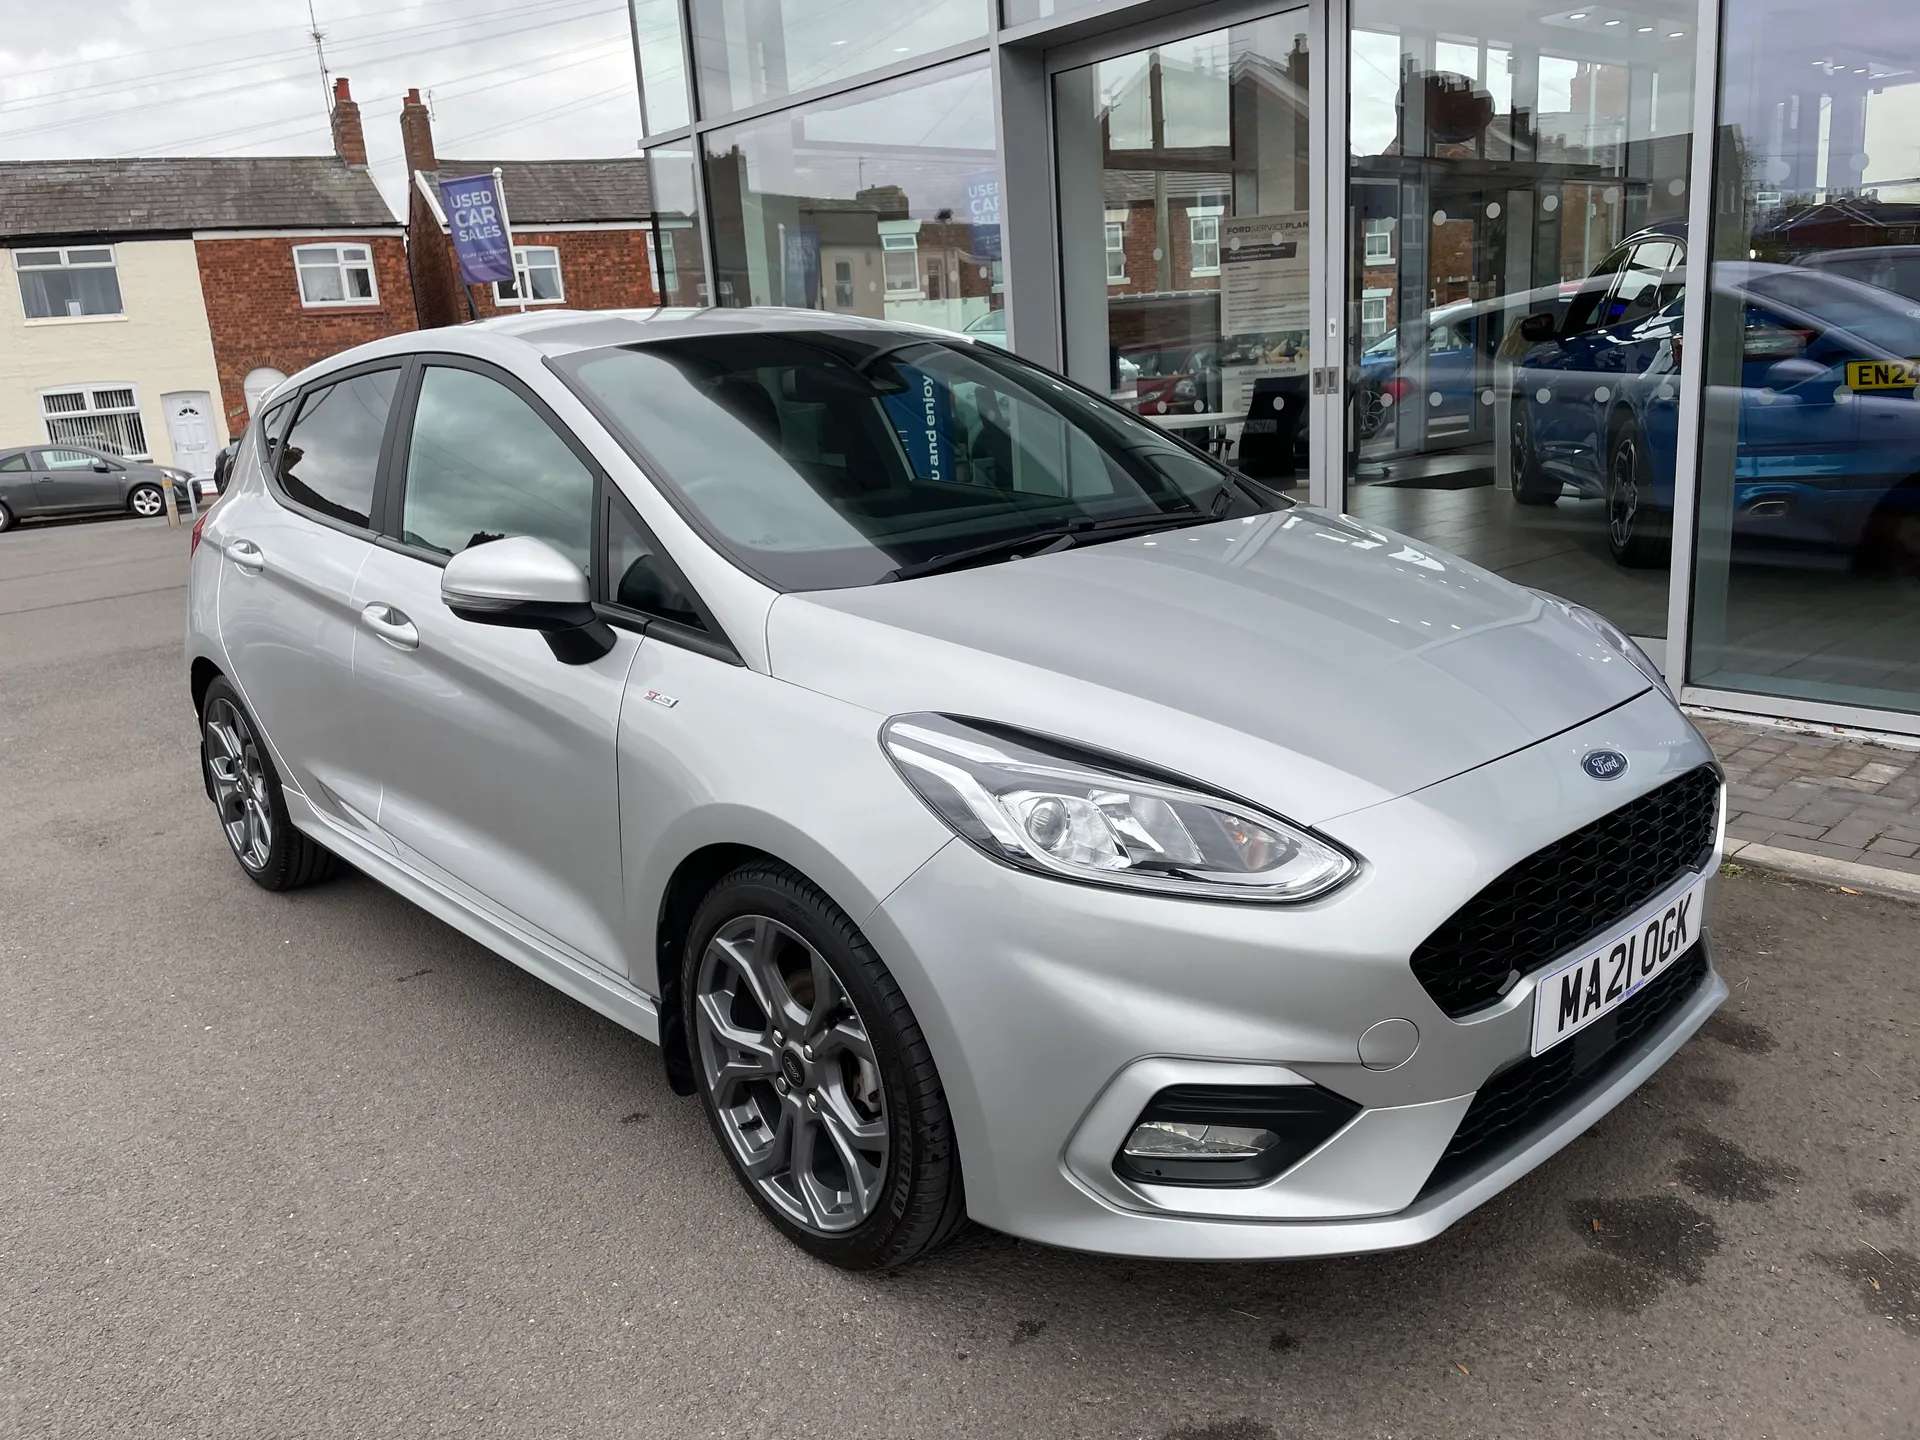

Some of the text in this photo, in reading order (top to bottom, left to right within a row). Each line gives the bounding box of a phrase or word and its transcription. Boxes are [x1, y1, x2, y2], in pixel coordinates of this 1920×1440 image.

[450, 190, 492, 208] USED
[455, 206, 497, 228] CAR
[459, 225, 502, 242] SALES
[923, 375, 936, 426] enjoy
[926, 430, 939, 466] and
[1591, 755, 1619, 775] Ford
[1557, 892, 1692, 1033] MA21 OGK
